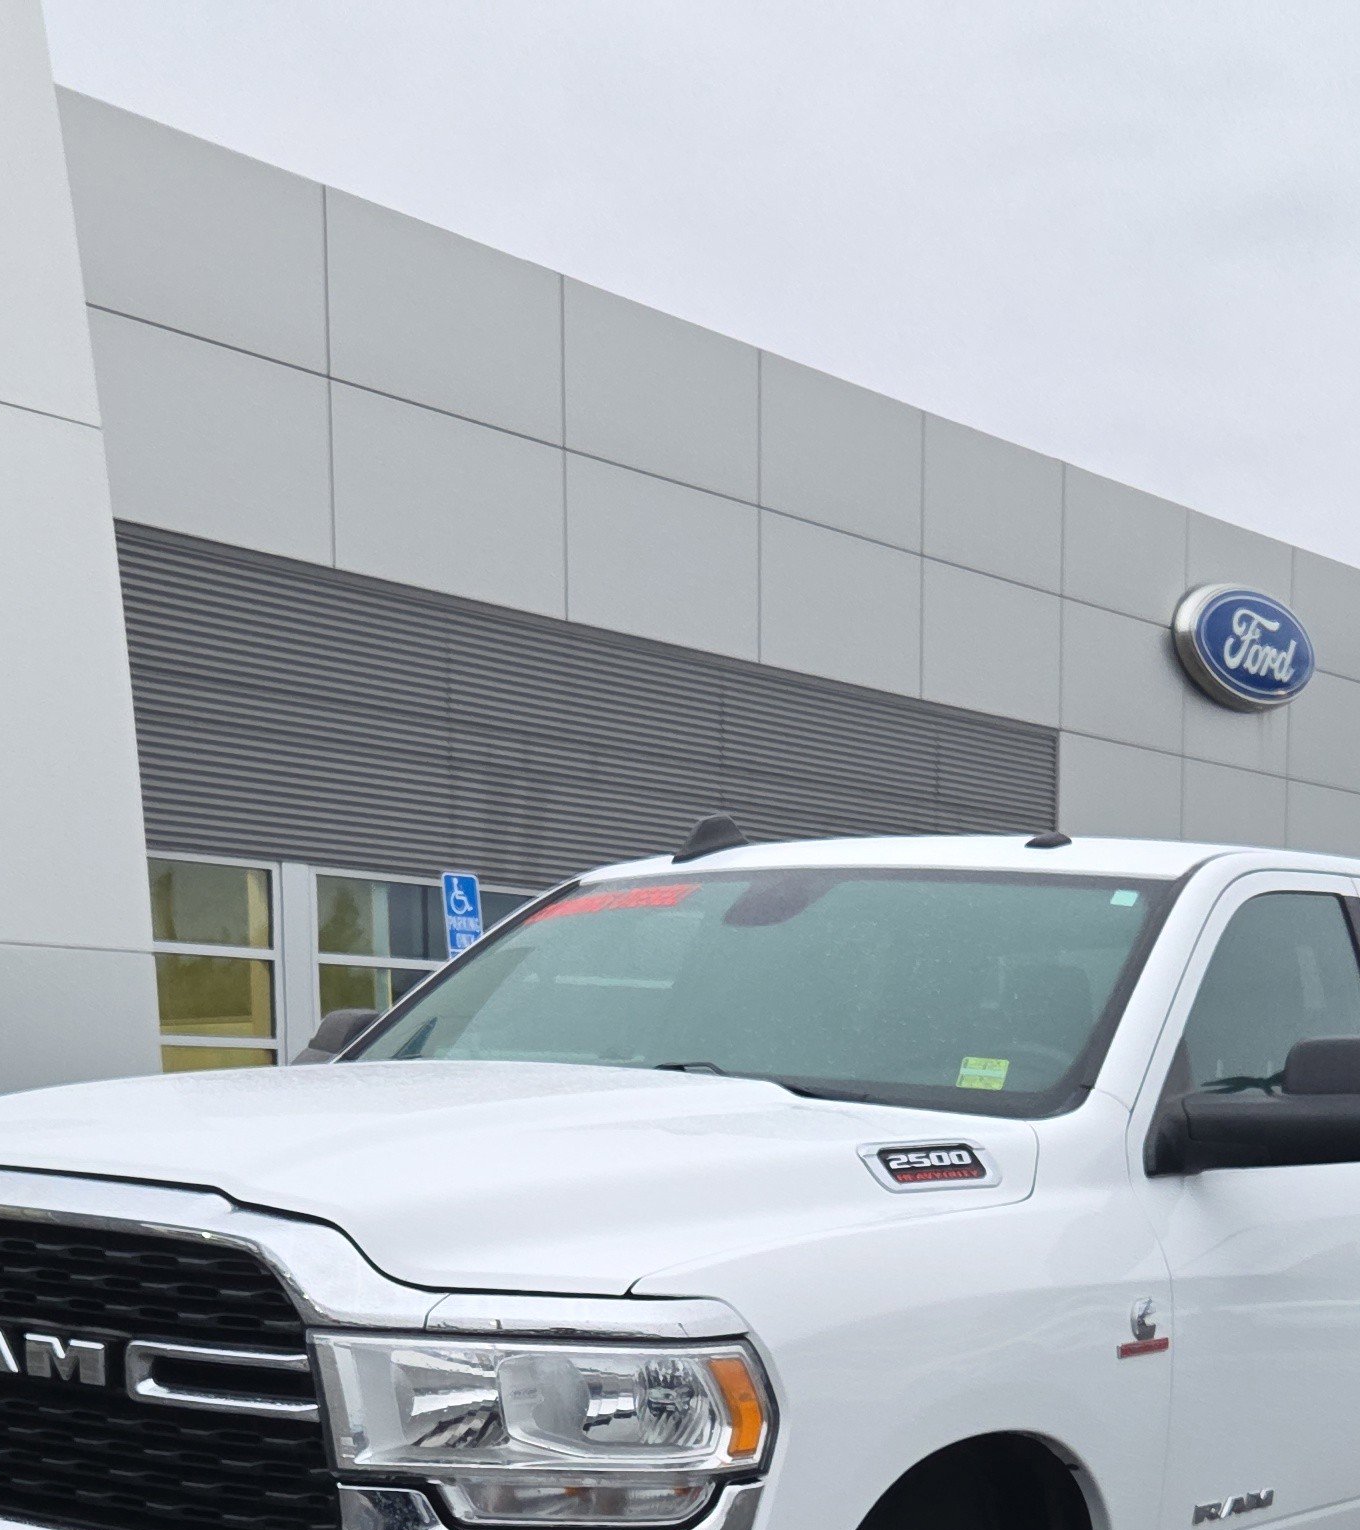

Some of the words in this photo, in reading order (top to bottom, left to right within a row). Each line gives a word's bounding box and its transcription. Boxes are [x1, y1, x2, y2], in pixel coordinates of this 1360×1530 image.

[1224, 608, 1297, 682] Ford
[887, 1150, 972, 1169] 2500
[1192, 1489, 1275, 1526] RAM
